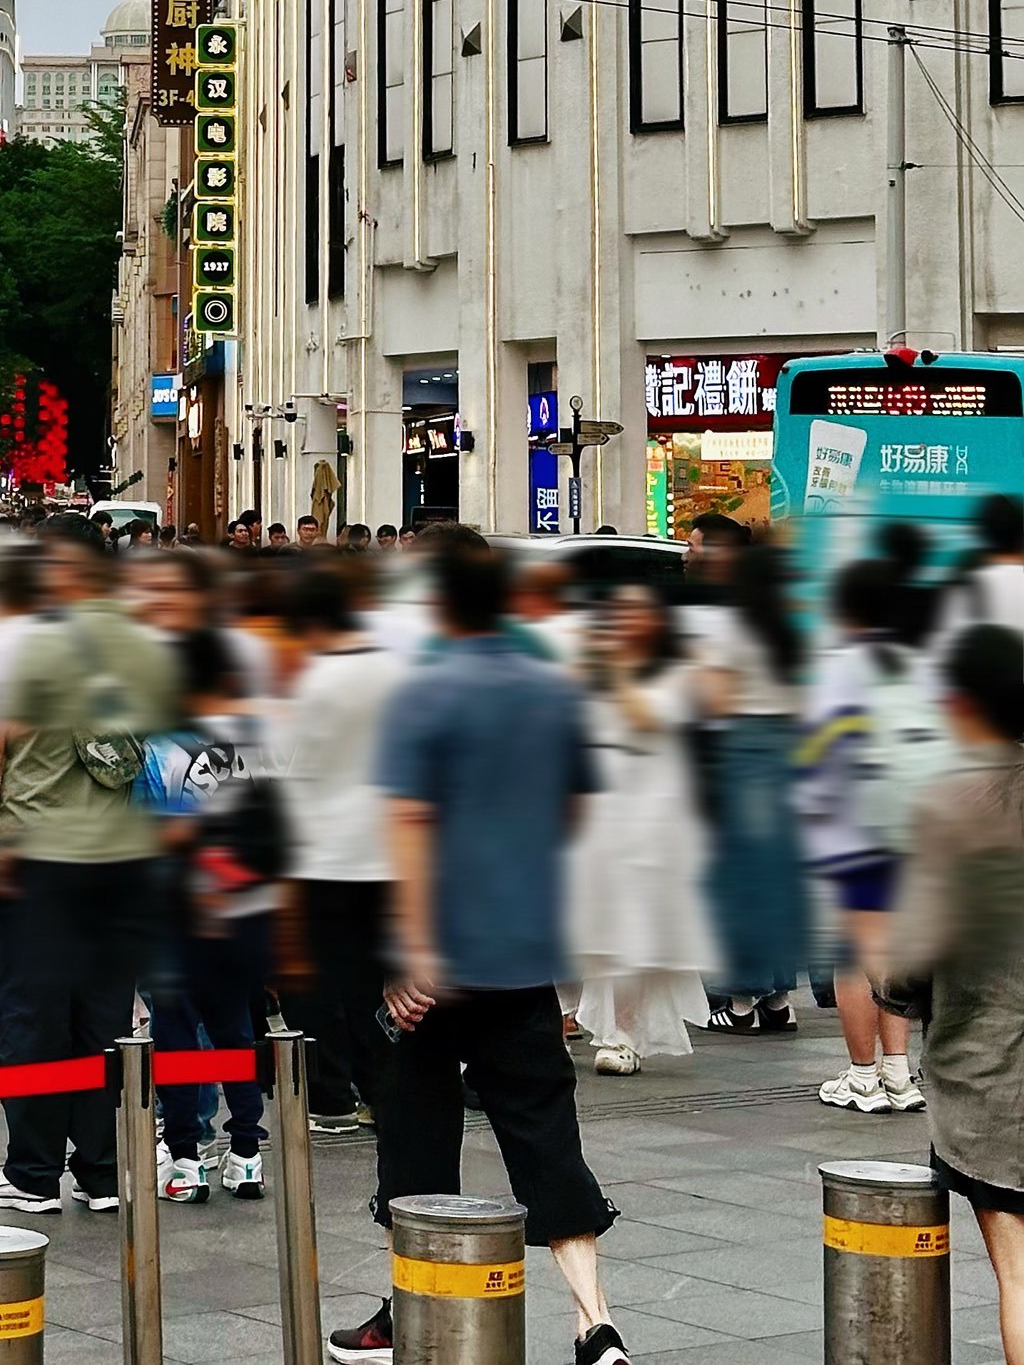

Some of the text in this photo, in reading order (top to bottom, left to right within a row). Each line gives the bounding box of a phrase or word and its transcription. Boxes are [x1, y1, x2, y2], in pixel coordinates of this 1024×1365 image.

[205, 35, 228, 232] 永汉电影院
[204, 261, 229, 272] 1927
[816, 446, 853, 468] 好易康
[879, 444, 950, 474] 好易康
